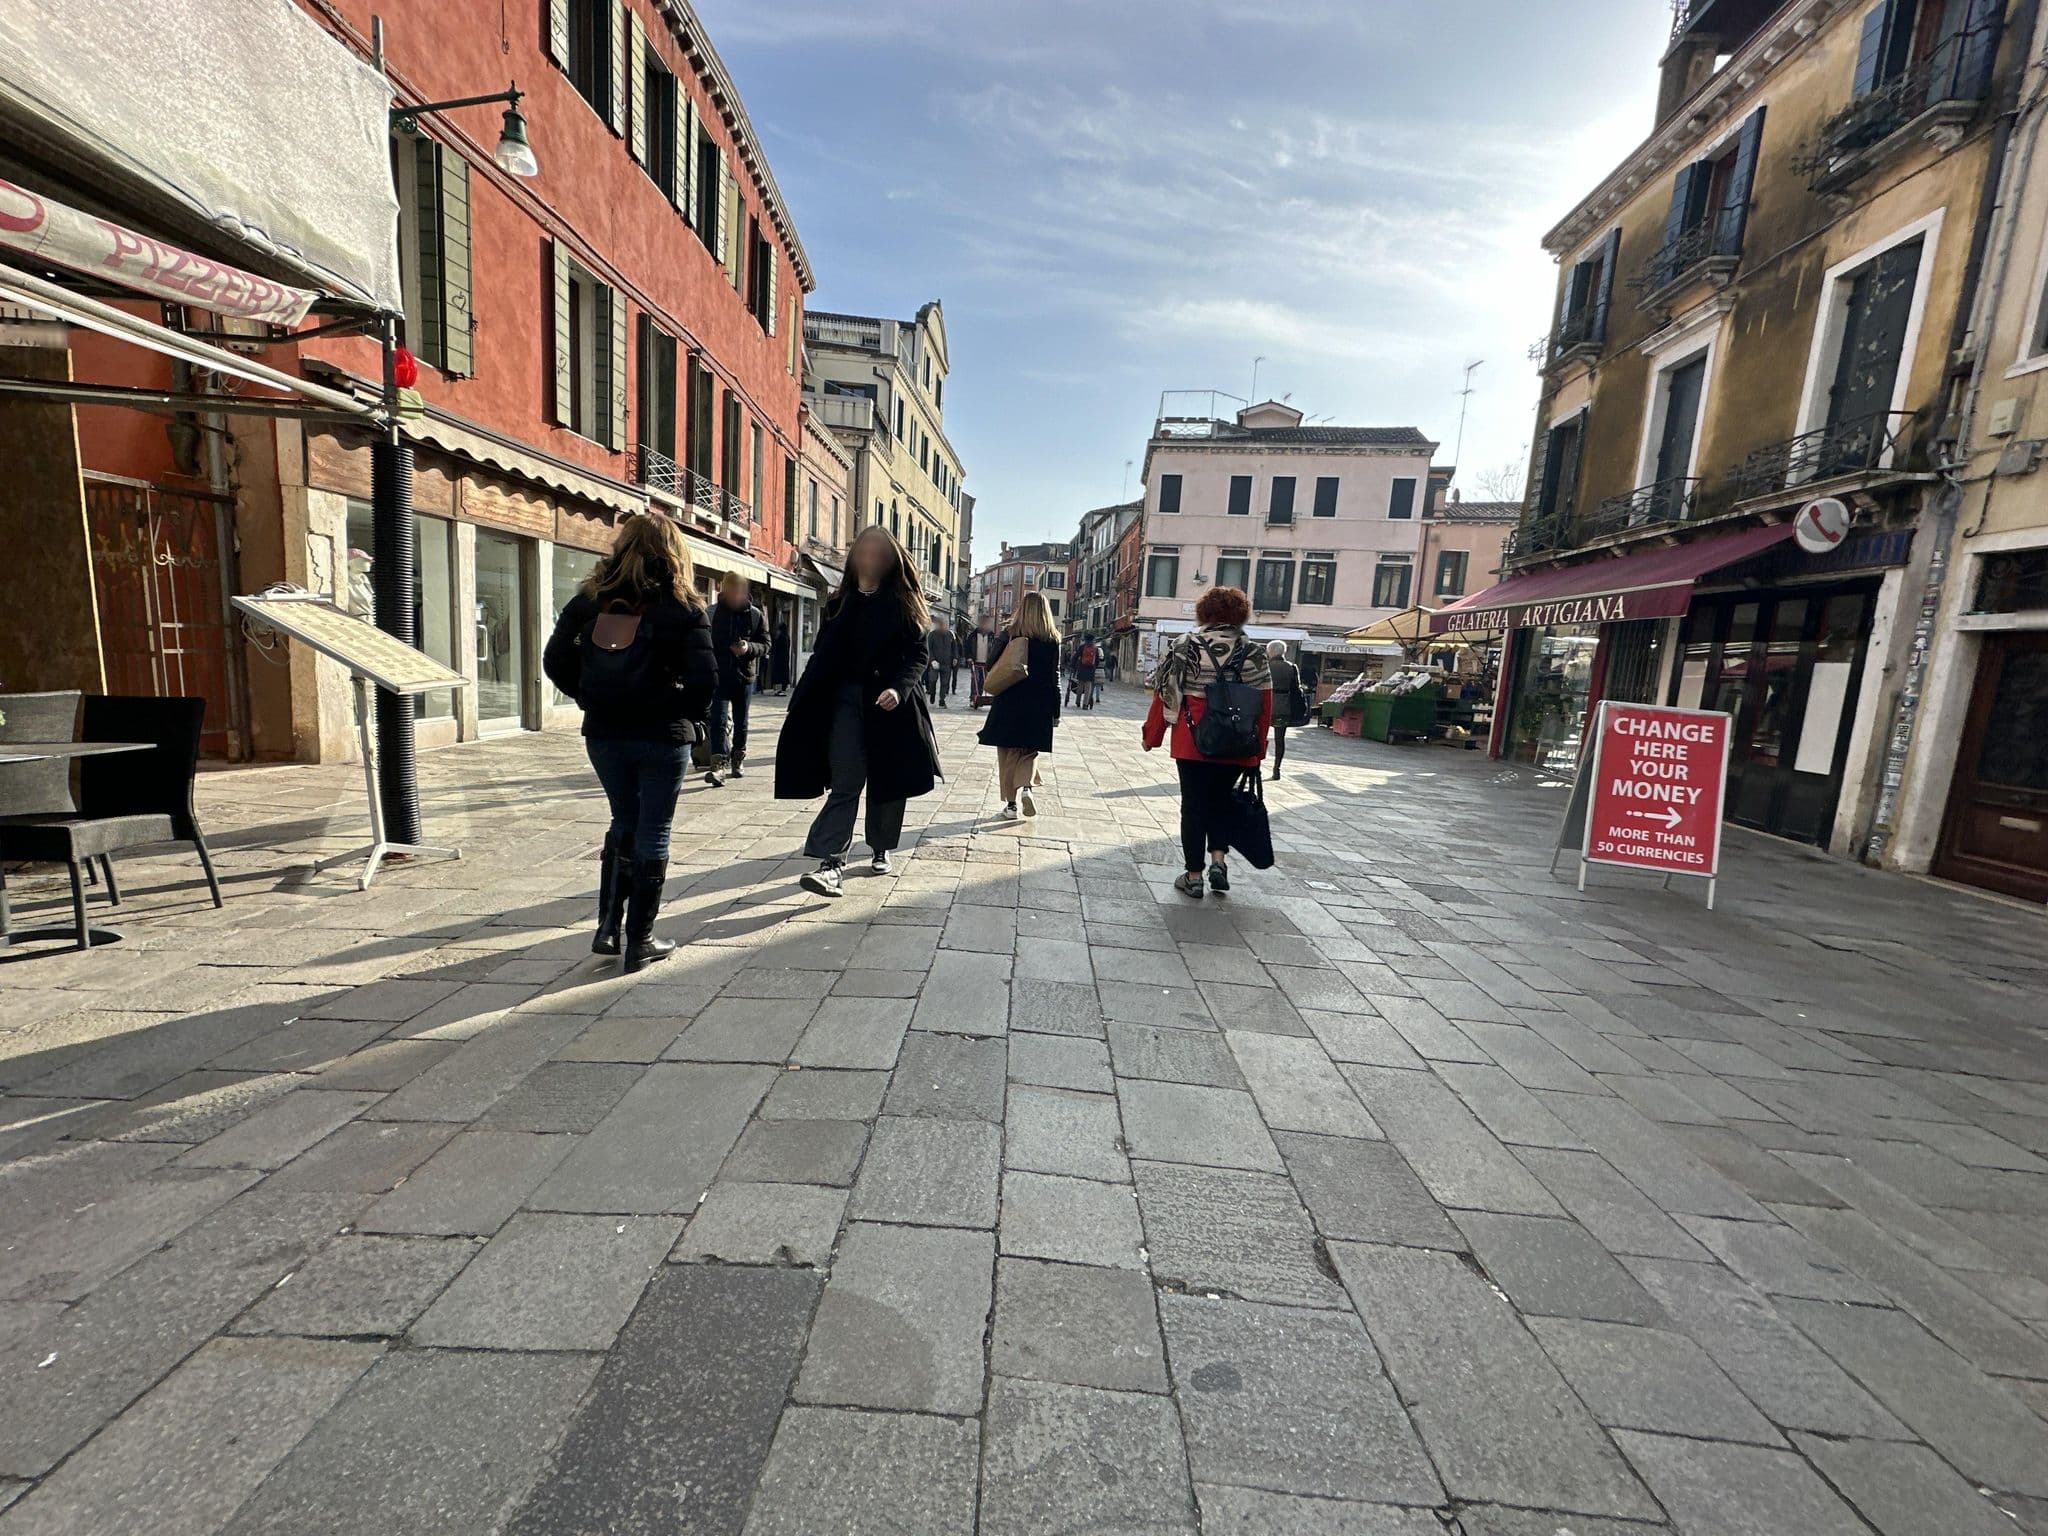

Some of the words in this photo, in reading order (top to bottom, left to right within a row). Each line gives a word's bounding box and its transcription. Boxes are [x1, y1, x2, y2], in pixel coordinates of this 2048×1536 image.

[95, 219, 304, 321] PIZZERIA
[1447, 609, 1509, 632] GELATERIA
[1520, 595, 1626, 627] ARTIGIANA
[1613, 717, 1715, 744] CHANGE
[1633, 740, 1689, 761] HERE
[1630, 759, 1689, 781] YOUR
[1611, 778, 1703, 805] MONEY
[1608, 826, 1650, 841] MORE
[1655, 831, 1696, 847] THAN
[1597, 841, 1614, 852] 50
[1616, 843, 1705, 864] CURRENCIES
